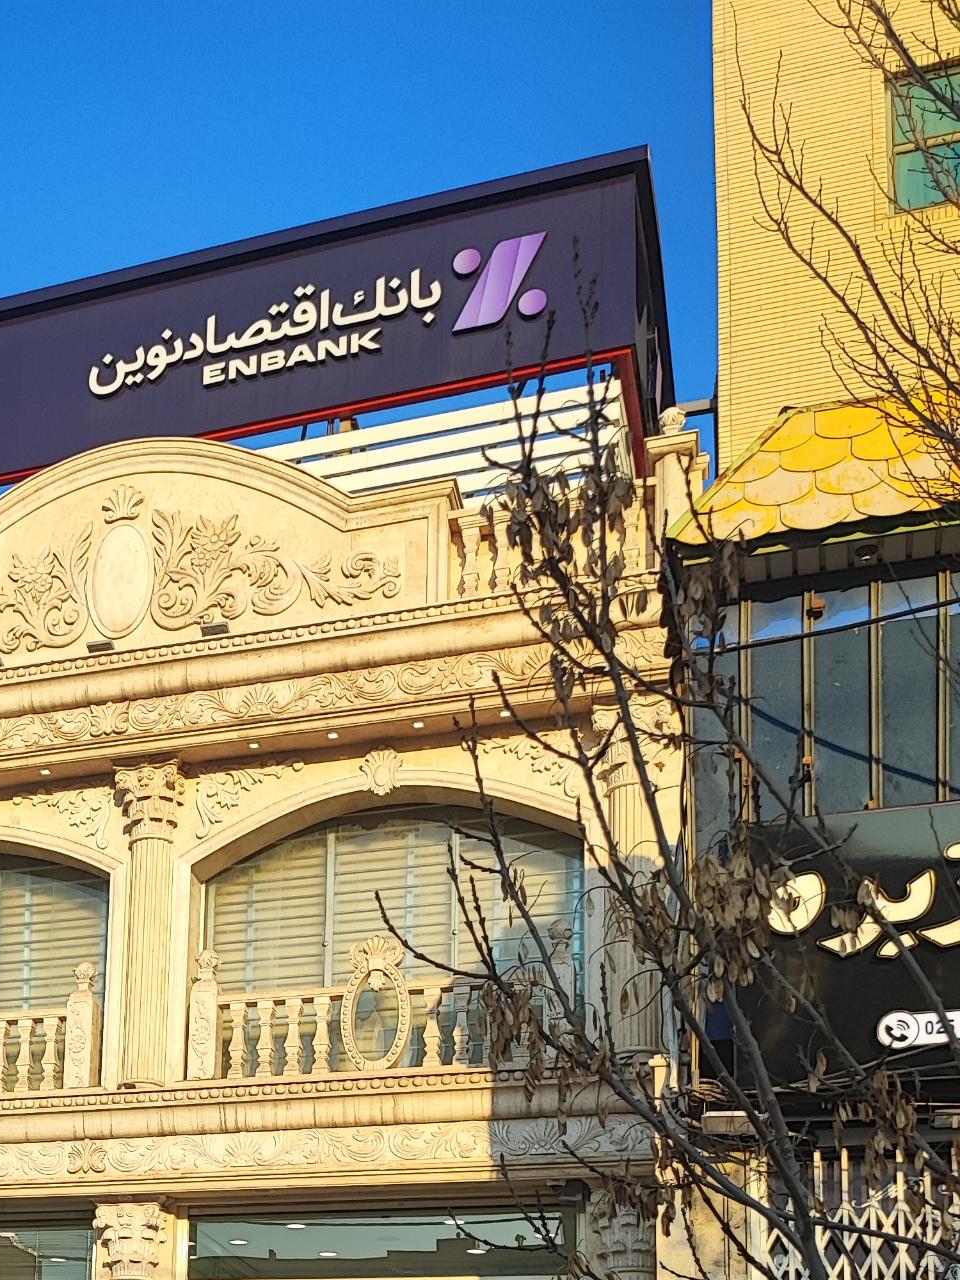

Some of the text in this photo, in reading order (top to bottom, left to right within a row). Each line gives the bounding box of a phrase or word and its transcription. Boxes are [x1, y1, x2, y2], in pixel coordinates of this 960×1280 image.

[182, 284, 331, 361] اقتصاد
[88, 328, 185, 395] نوین
[202, 327, 382, 386] ENBANK
